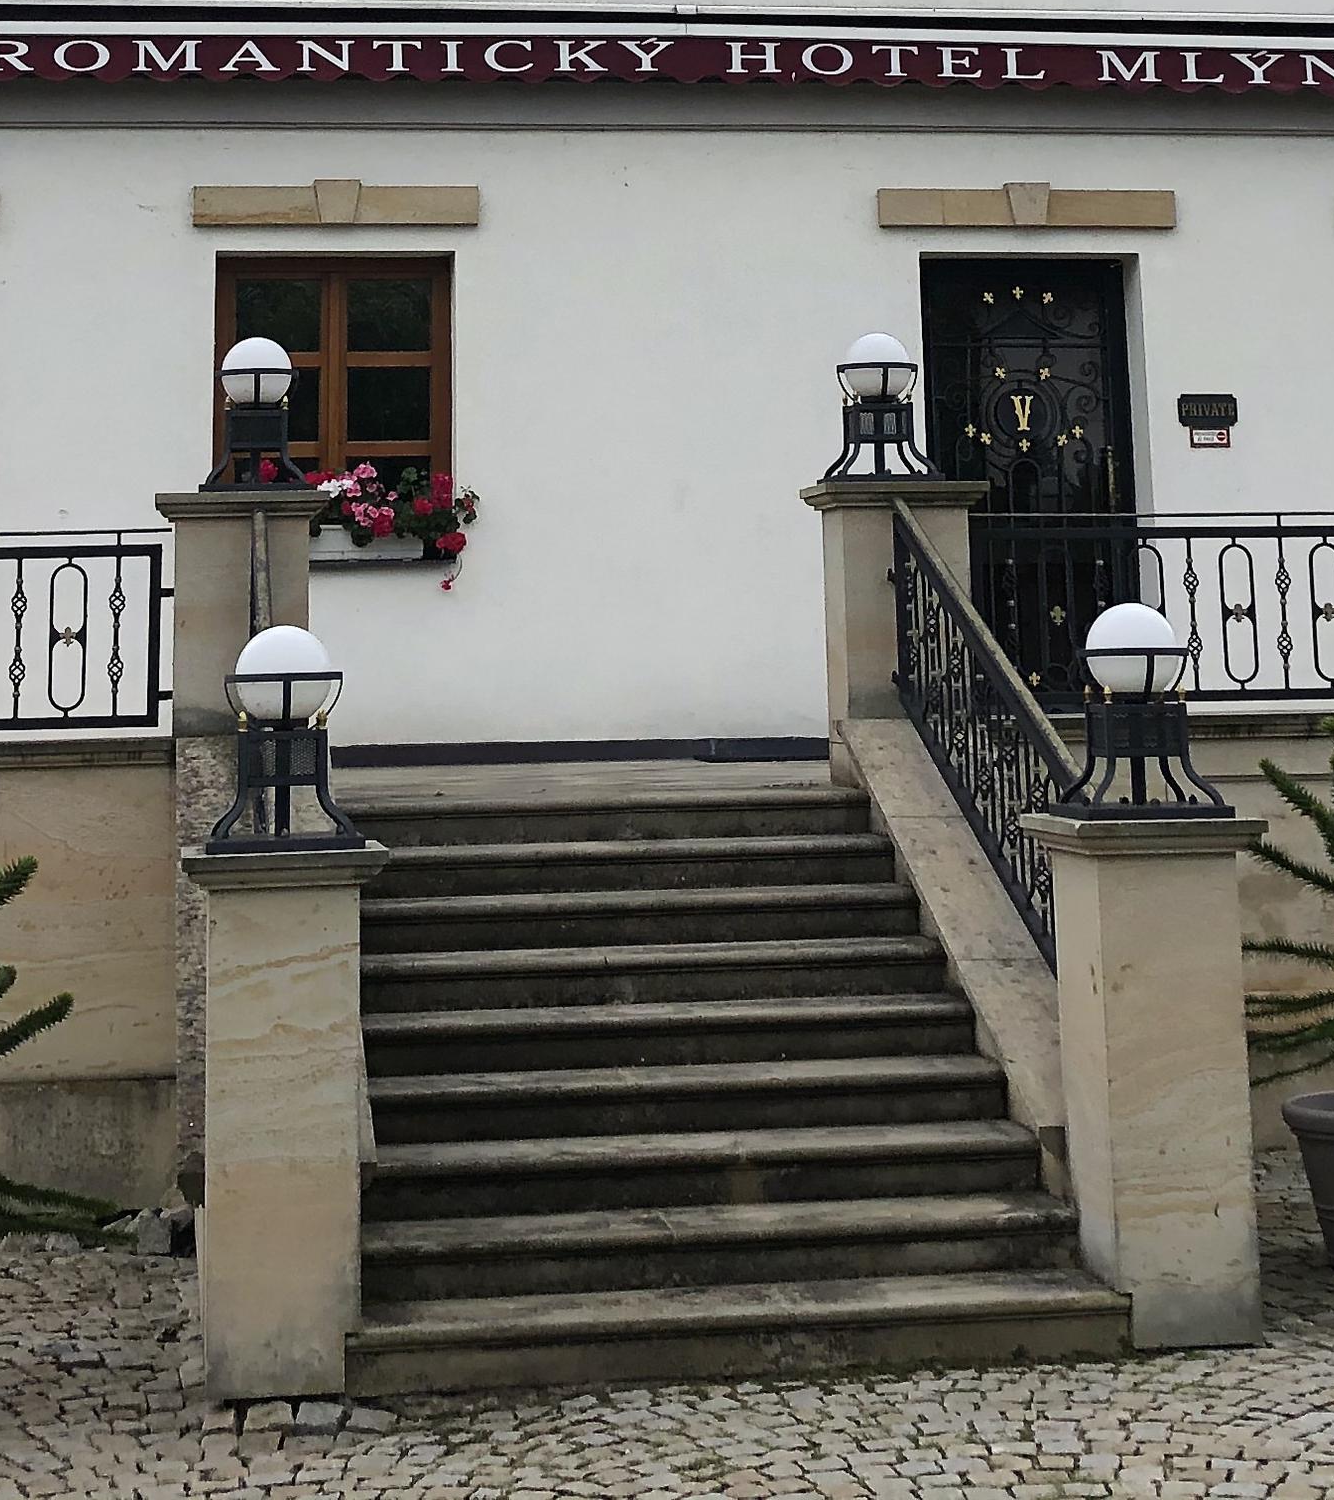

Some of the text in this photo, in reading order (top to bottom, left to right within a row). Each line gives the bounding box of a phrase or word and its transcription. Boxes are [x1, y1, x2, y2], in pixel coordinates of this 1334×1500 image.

[725, 41, 1046, 81] HOTEL
[1010, 395, 1035, 432] V
[1181, 402, 1235, 417] PRIVATE
